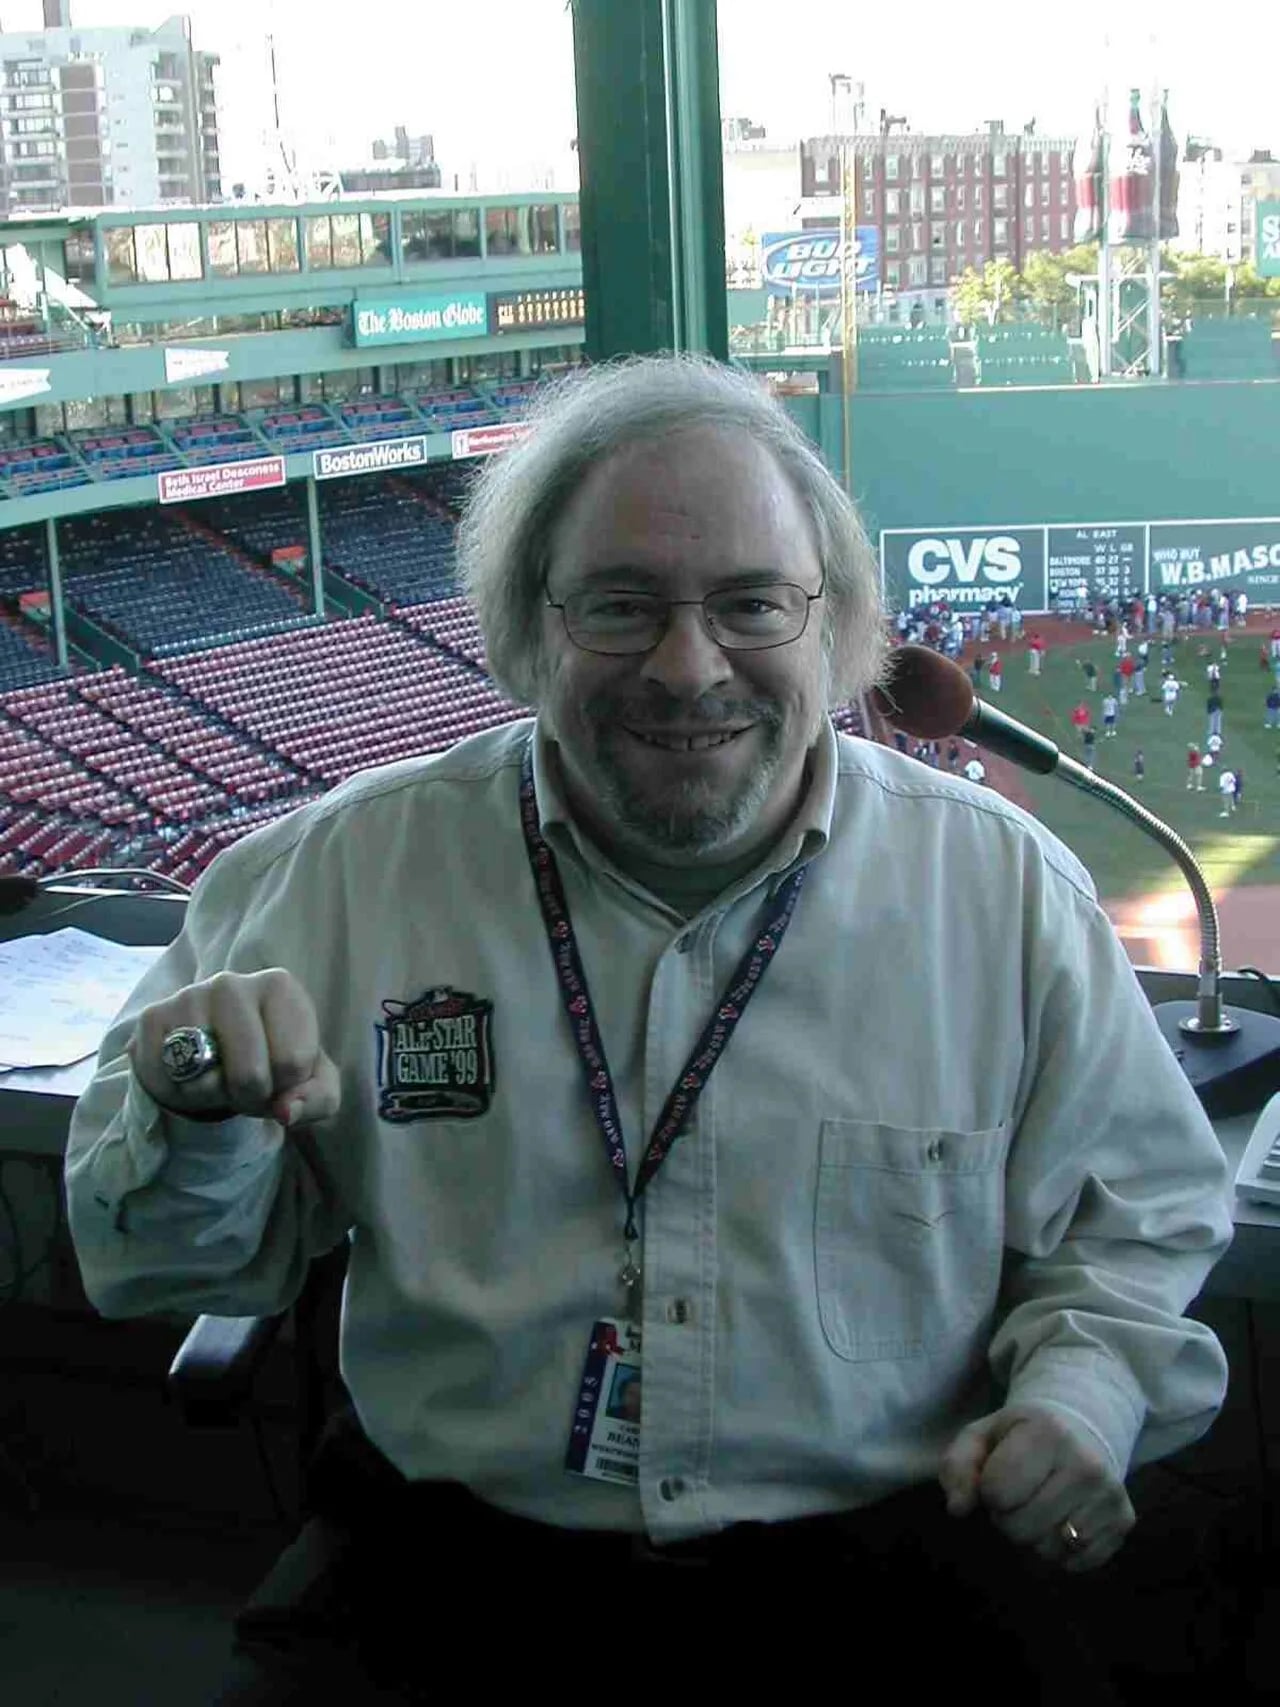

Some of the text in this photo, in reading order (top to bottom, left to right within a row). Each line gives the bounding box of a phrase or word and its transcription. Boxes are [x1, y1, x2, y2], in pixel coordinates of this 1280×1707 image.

[786, 239, 861, 260] BUD
[771, 257, 876, 279] LIGHT
[358, 309, 386, 336] The
[388, 307, 441, 333] Boston
[442, 302, 484, 328] Globe
[320, 443, 421, 473] BostonWorks
[165, 463, 279, 487] Beth Israel Deaconess
[166, 478, 244, 498] Medical Center
[1076, 529, 1118, 539] AL EAST
[908, 536, 1022, 585] CVS
[1180, 546, 1201, 560] BUT
[1049, 567, 1081, 577] BOSTON
[909, 585, 1019, 608] pharmacy
[398, 1049, 478, 1085] GAME '99
